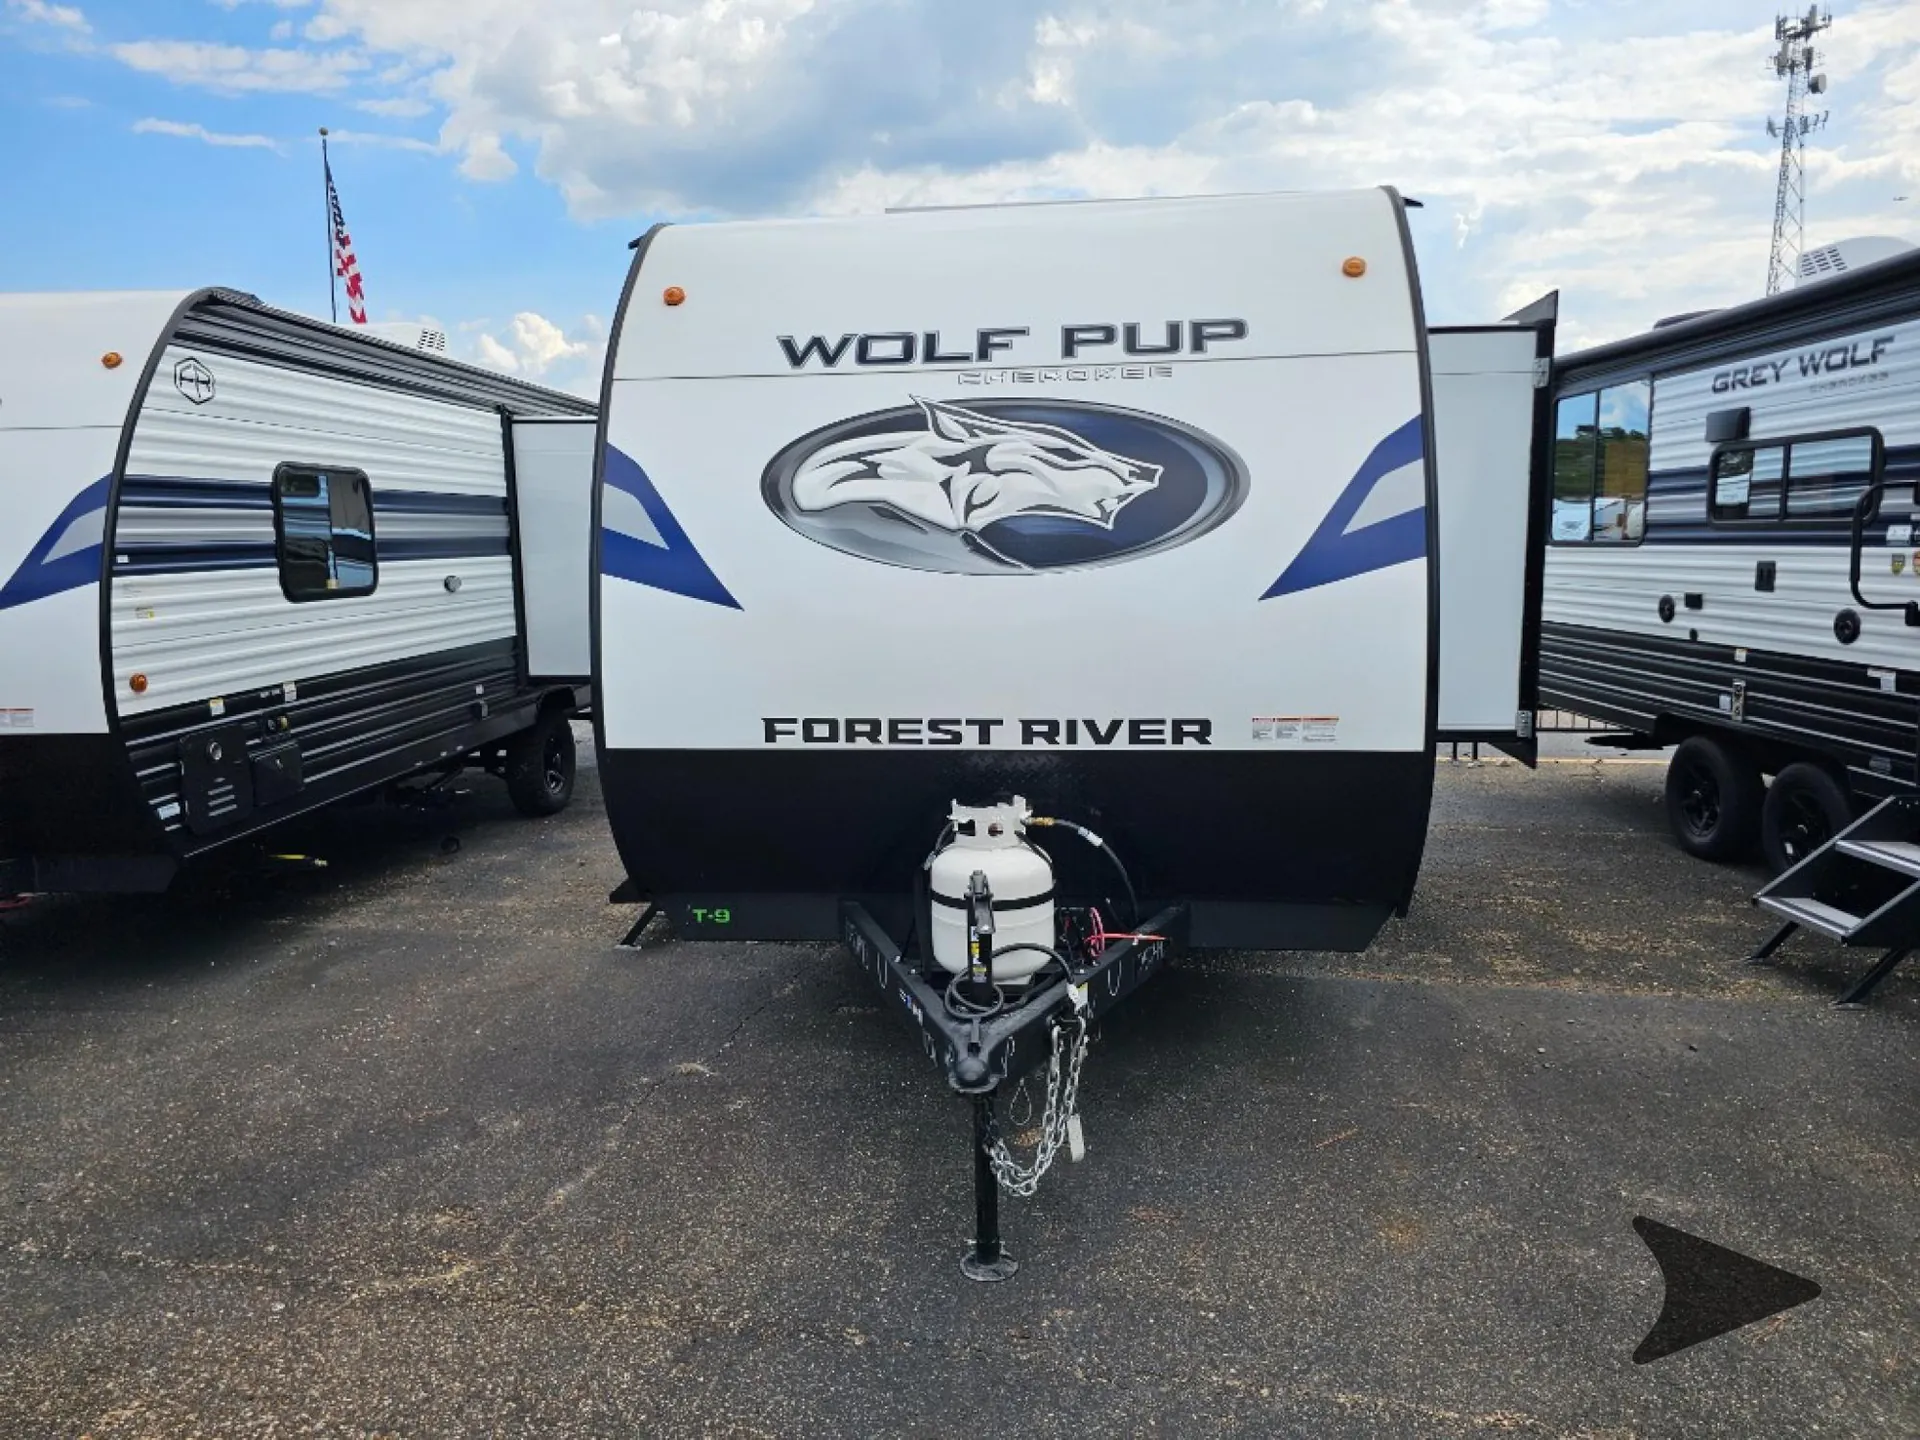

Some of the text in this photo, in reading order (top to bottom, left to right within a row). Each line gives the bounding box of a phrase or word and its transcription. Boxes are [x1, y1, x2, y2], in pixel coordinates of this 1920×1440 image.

[776, 318, 1249, 369] WOLF PUP
[957, 365, 1173, 385] CHEROKEE
[1712, 335, 1895, 393] GREY WOLF
[761, 717, 1212, 745] FOREST RIVER
[692, 908, 731, 924] T-9
